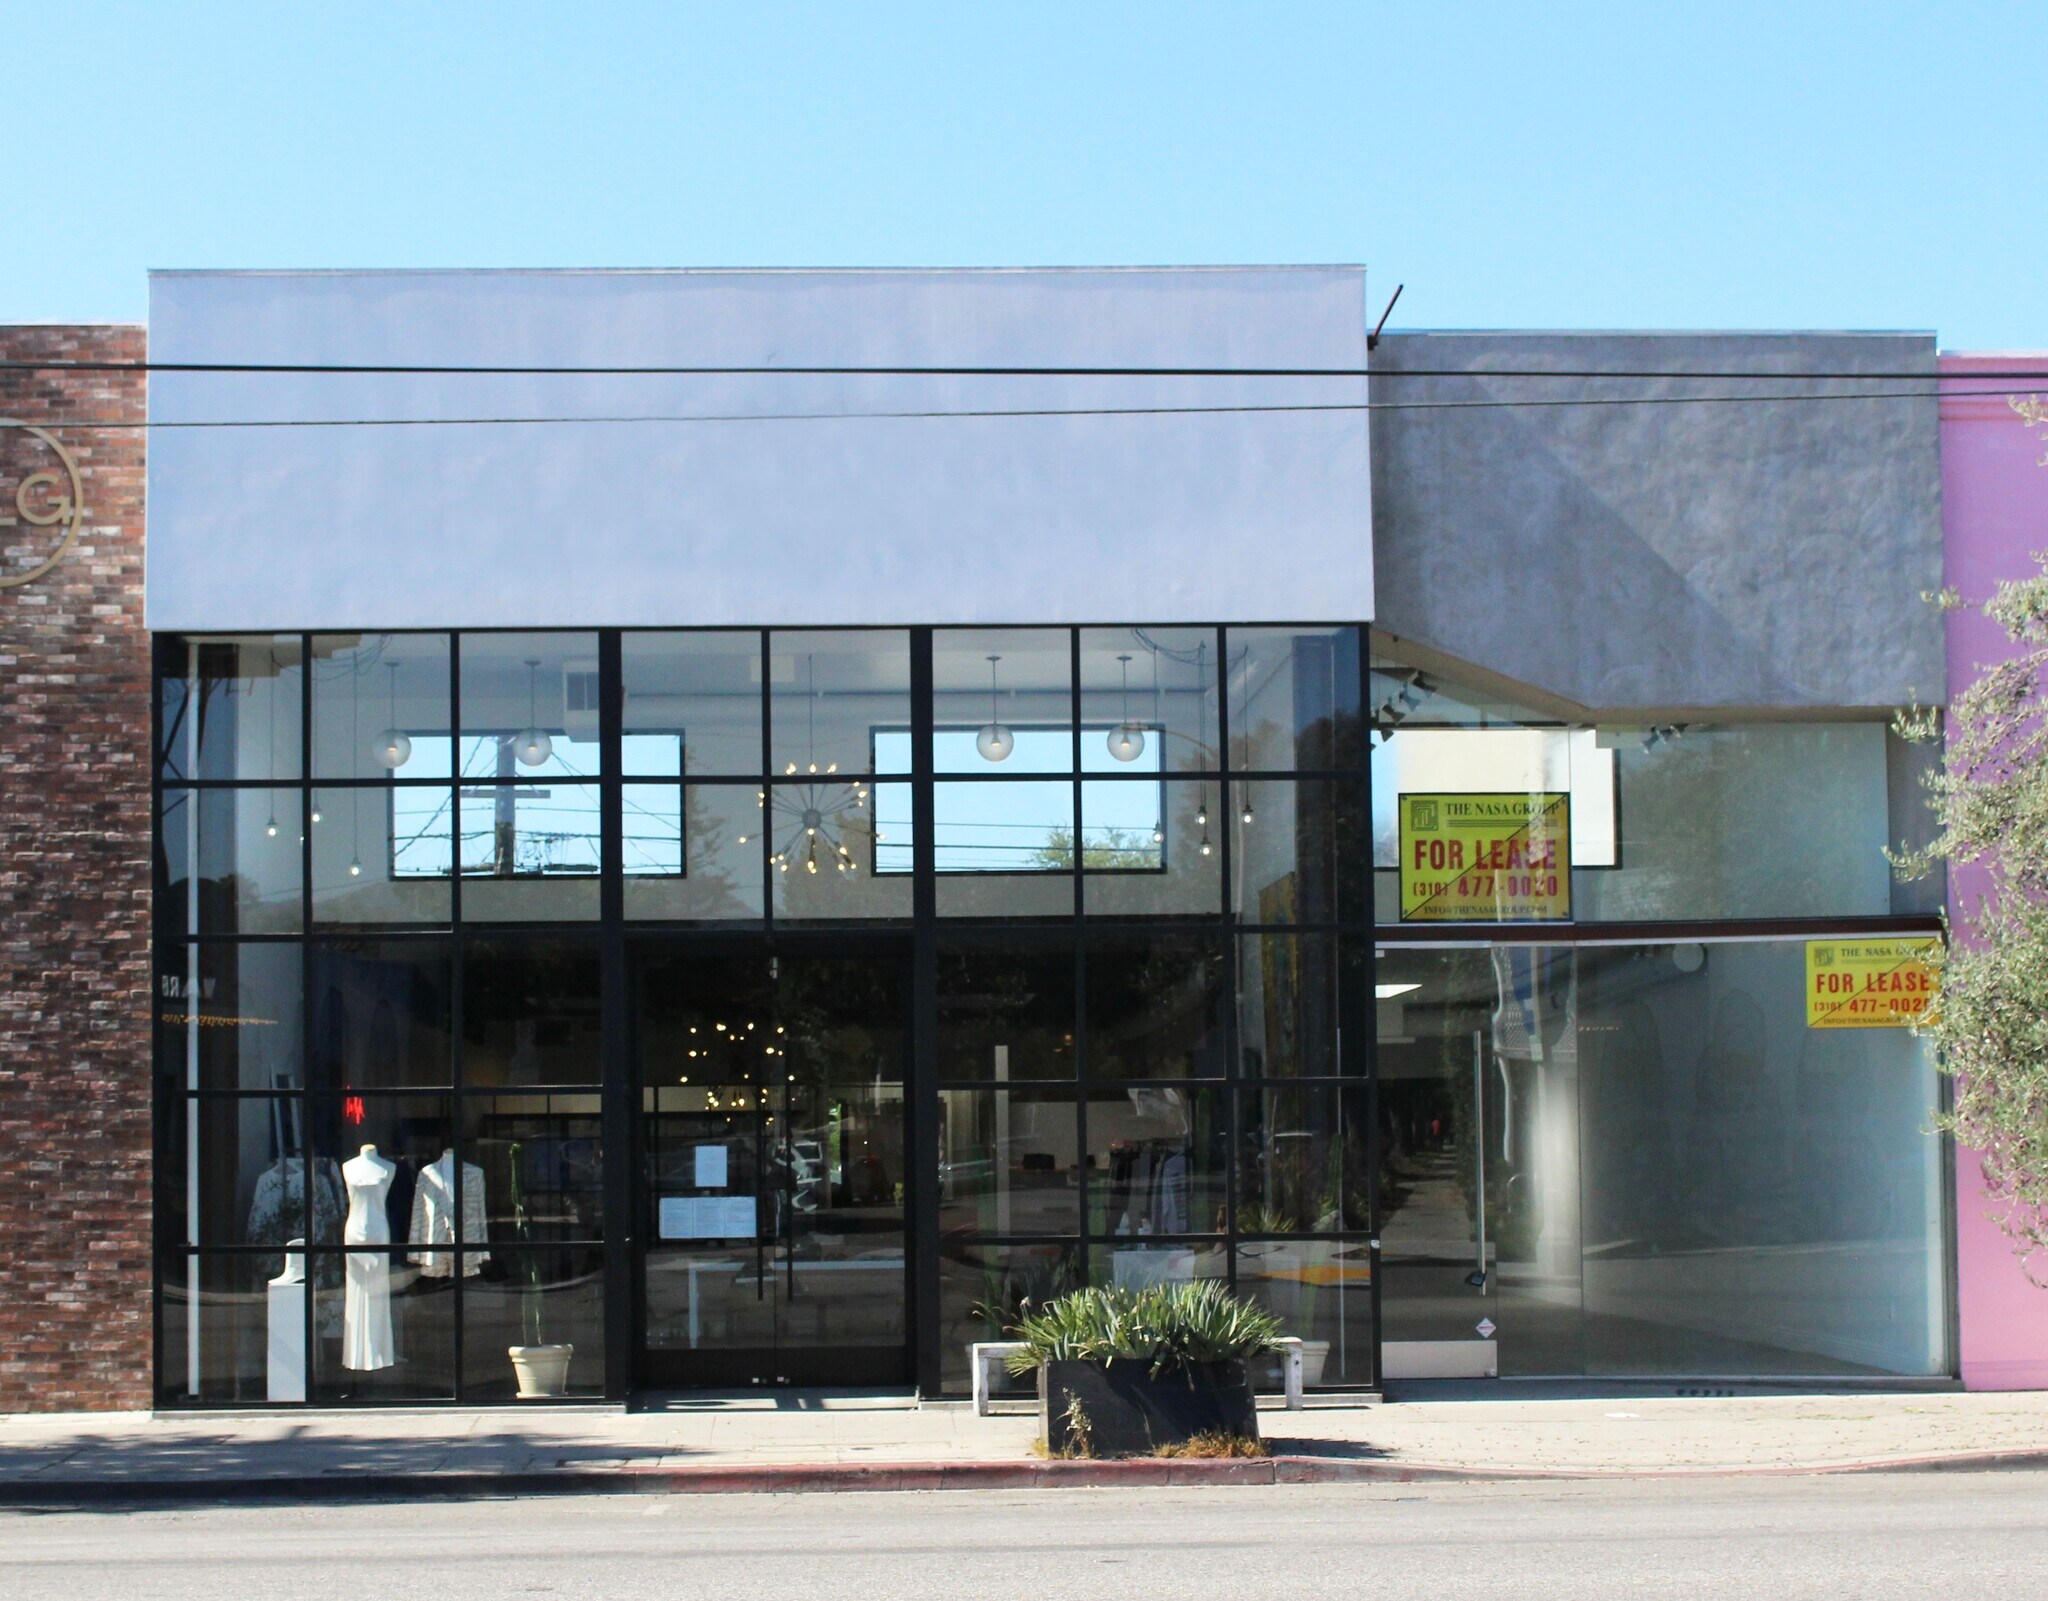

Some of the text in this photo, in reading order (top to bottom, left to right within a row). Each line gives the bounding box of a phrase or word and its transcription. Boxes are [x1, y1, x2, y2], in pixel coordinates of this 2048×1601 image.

[1445, 803, 1472, 816] THE
[1475, 803, 1509, 816] NASA
[1414, 839, 1557, 870] FOR LEASE
[1840, 948, 1861, 957] THE
[1865, 947, 1891, 957] NASA
[1816, 971, 1930, 993] FOR LEASE
